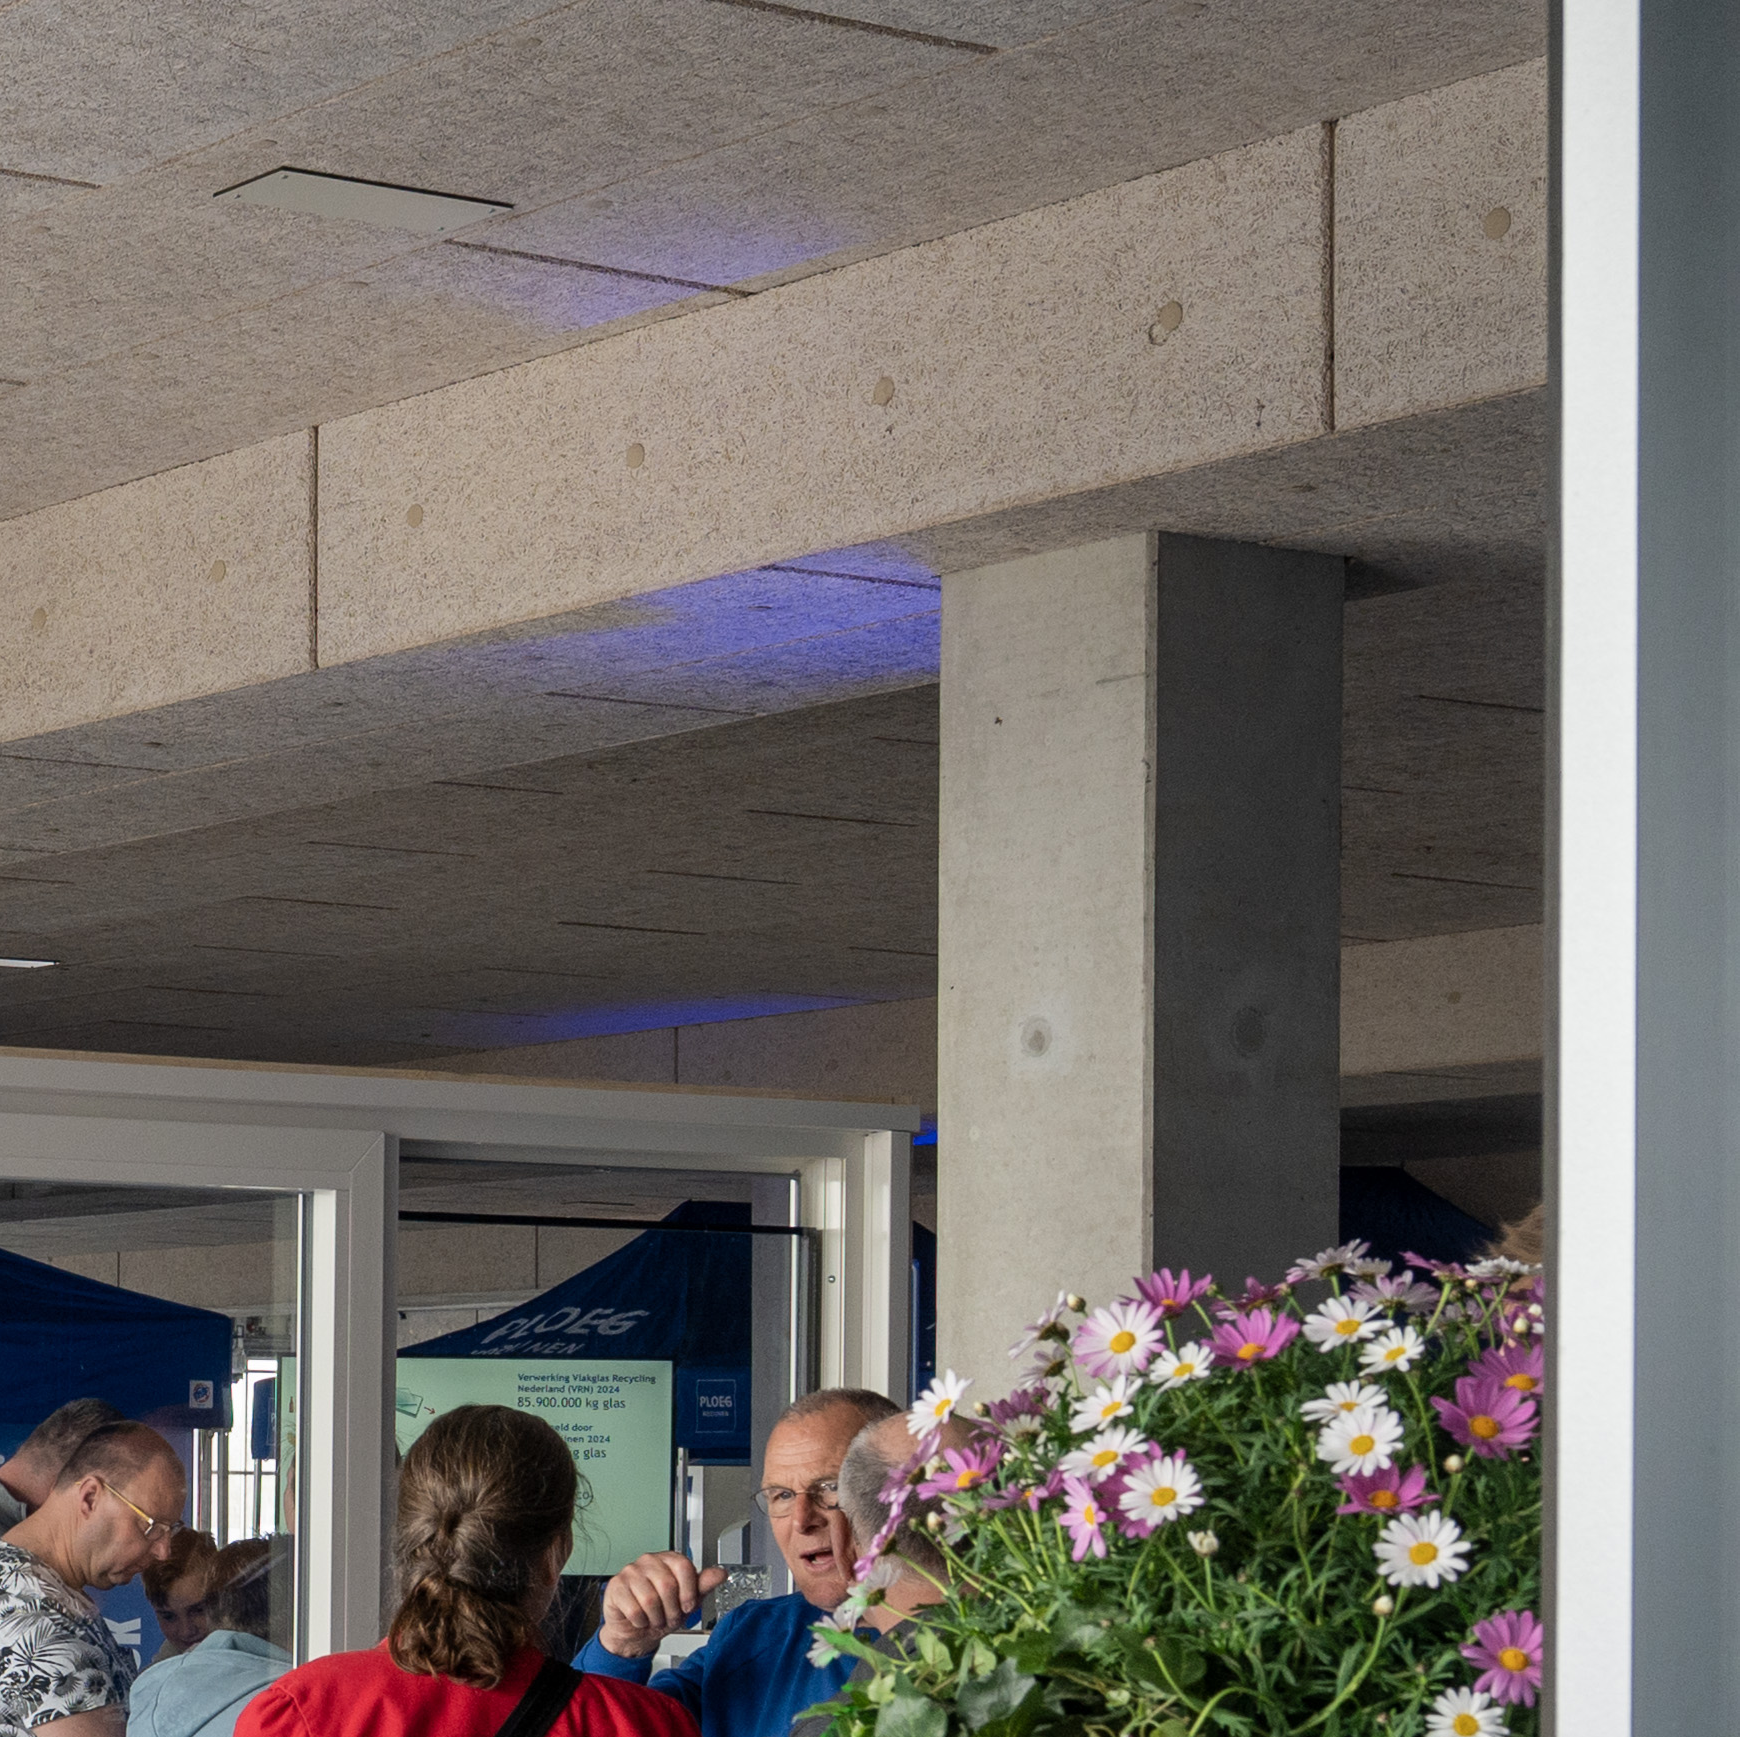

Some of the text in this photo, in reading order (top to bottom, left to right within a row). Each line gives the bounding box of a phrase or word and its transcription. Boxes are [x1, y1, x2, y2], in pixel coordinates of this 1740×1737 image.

[480, 1306, 651, 1345] PLOEG
[518, 1373, 656, 1384] Verwerking Vlakglas Recycling
[518, 1385, 620, 1395] Nederland (VRN) 2024
[517, 1397, 626, 1410] 85.900.000 kg glas
[699, 1396, 733, 1408] PLOEG
[572, 1423, 593, 1431] door
[587, 1435, 611, 1443] 2024
[583, 1447, 607, 1460] glas
